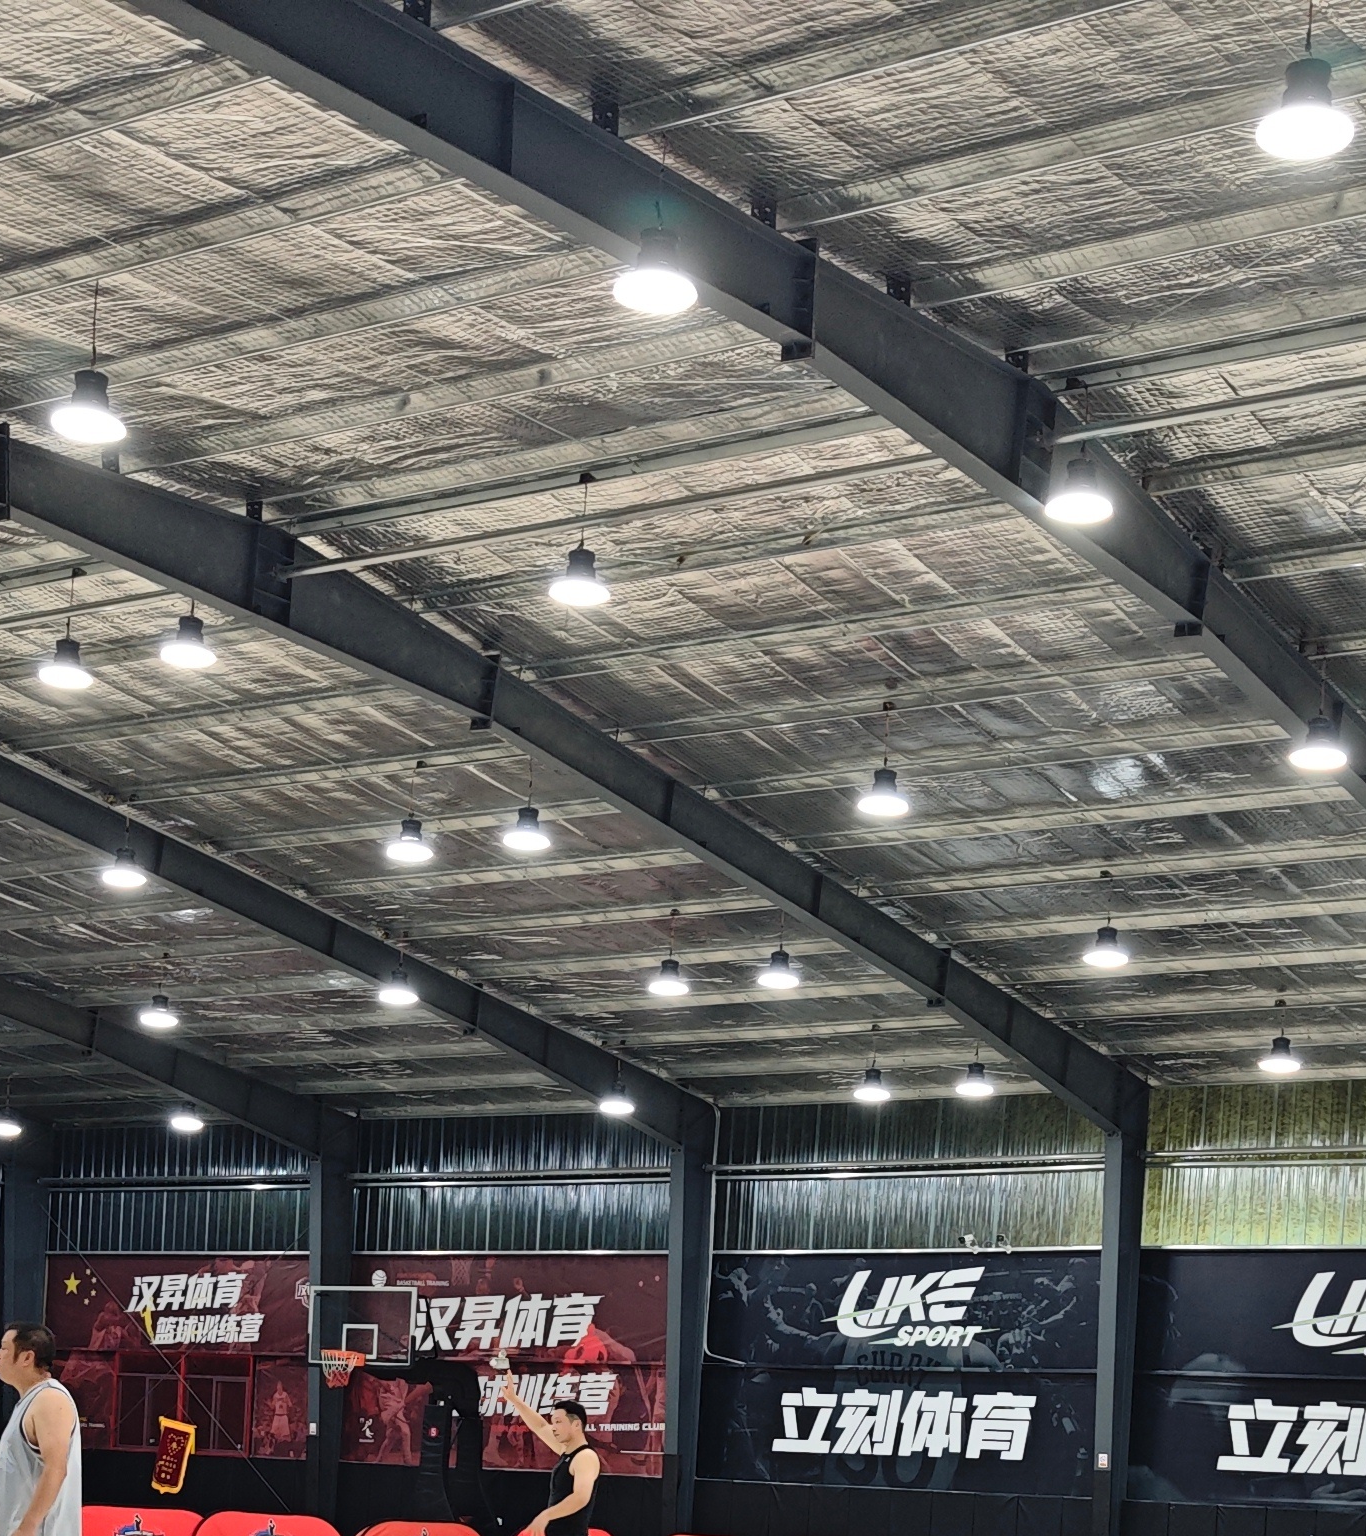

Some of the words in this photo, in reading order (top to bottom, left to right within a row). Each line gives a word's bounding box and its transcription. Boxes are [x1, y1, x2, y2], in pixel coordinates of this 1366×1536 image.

[124, 1273, 246, 1313] 汉昇体育
[836, 1266, 985, 1338] LIKE
[151, 1313, 265, 1345] 篮球训练营
[414, 1293, 605, 1351] 汉昇体育
[892, 1326, 983, 1347] SPORT
[478, 1372, 618, 1418] 球训练营
[599, 1423, 640, 1432] TRAINING
[772, 1386, 1037, 1460] 立刻体育
